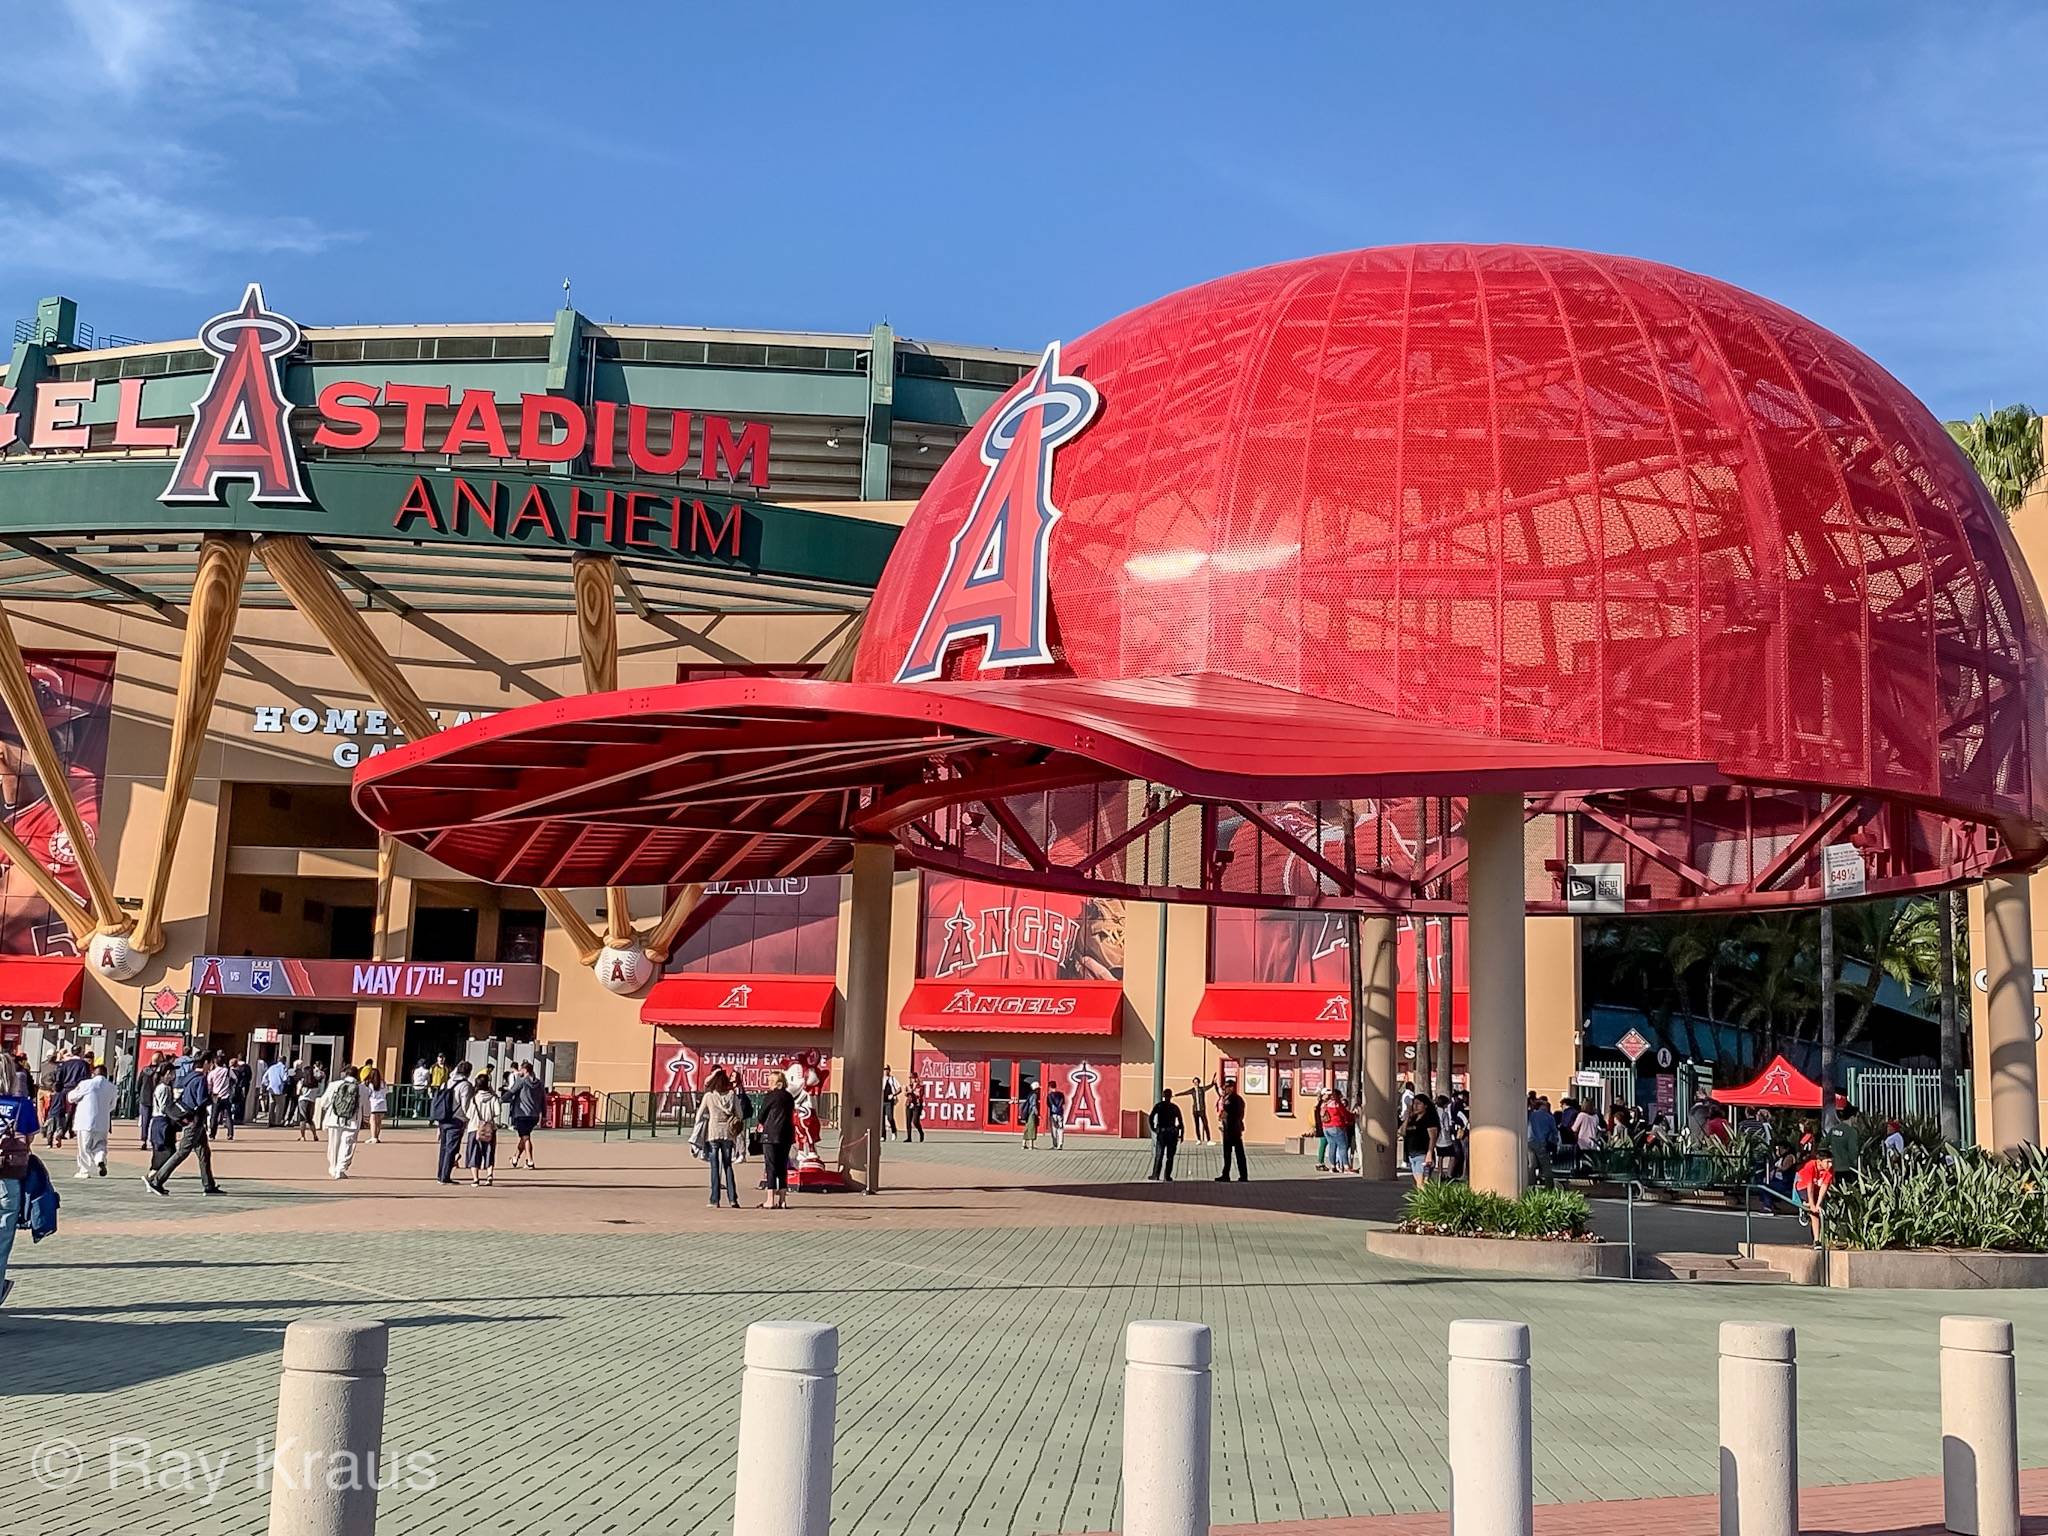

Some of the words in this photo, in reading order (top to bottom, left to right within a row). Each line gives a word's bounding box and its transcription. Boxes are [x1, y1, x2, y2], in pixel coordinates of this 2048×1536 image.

[312, 380, 771, 488] STADIUM
[392, 474, 743, 557] ANAHEIM
[1598, 880, 1618, 888] NEW
[1598, 888, 1618, 896] ERA
[352, 964, 402, 995] MAY
[405, 966, 445, 996] 17TH
[462, 968, 504, 998] 19TH
[941, 988, 1077, 1015] ANGELS
[0, 1009, 75, 1024] CALL
[143, 1019, 186, 1030] DIRECTORY
[145, 1040, 179, 1050] WELCOME
[703, 1052, 759, 1066] STADIUM
[920, 1056, 977, 1079] ANGELS
[923, 1080, 971, 1100] TEAM
